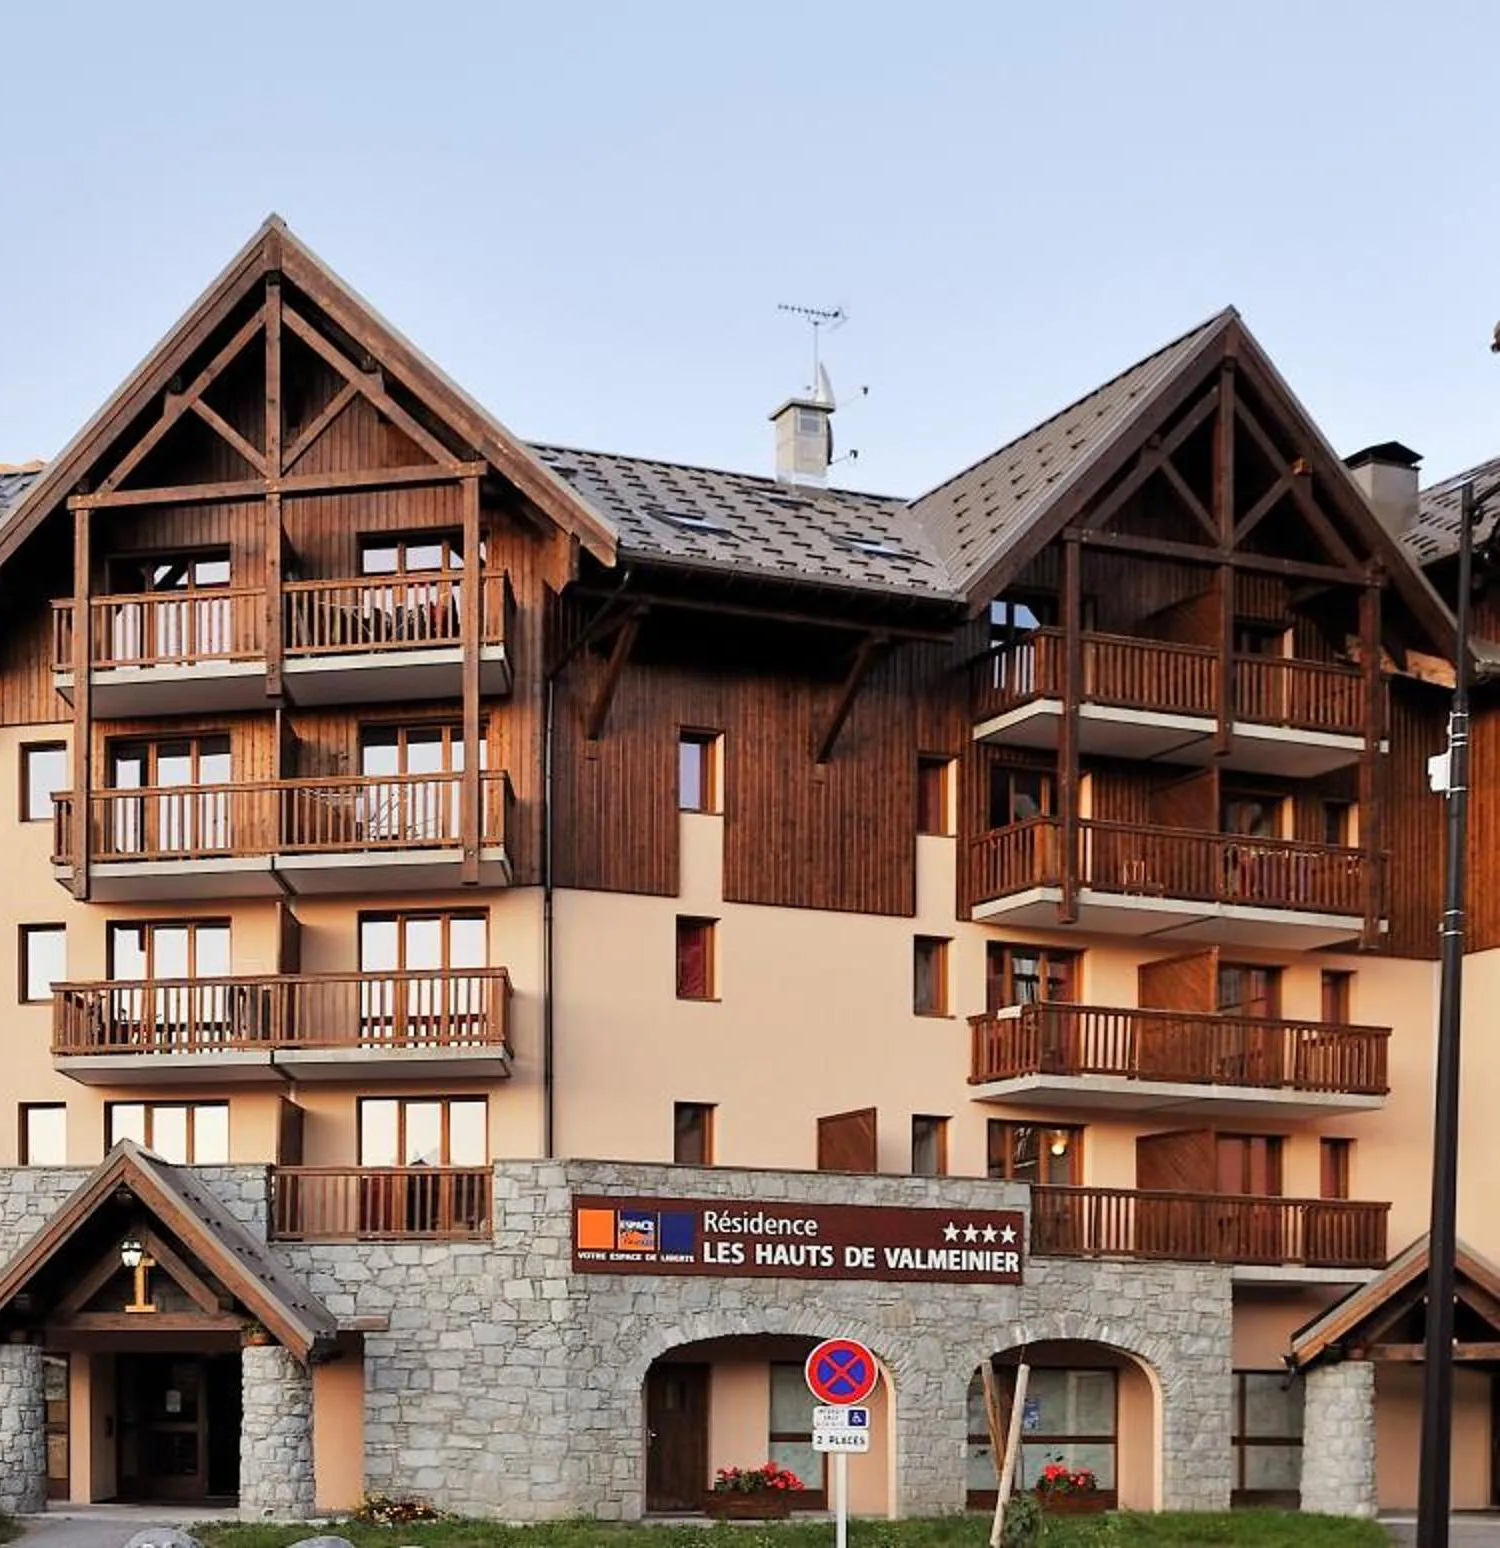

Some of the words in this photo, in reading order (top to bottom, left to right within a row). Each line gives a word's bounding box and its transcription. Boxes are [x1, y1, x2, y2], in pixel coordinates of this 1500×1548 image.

[703, 1210, 819, 1236] Résidence
[577, 1251, 607, 1260] VOTRE
[609, 1253, 643, 1261] ESPACE
[703, 1241, 746, 1264] LES
[755, 1243, 835, 1267] HAUTS
[844, 1246, 876, 1269] DE
[883, 1247, 1020, 1273] VALMEINIER
[816, 1435, 823, 1445] 2
[829, 1435, 866, 1446] PLACES
